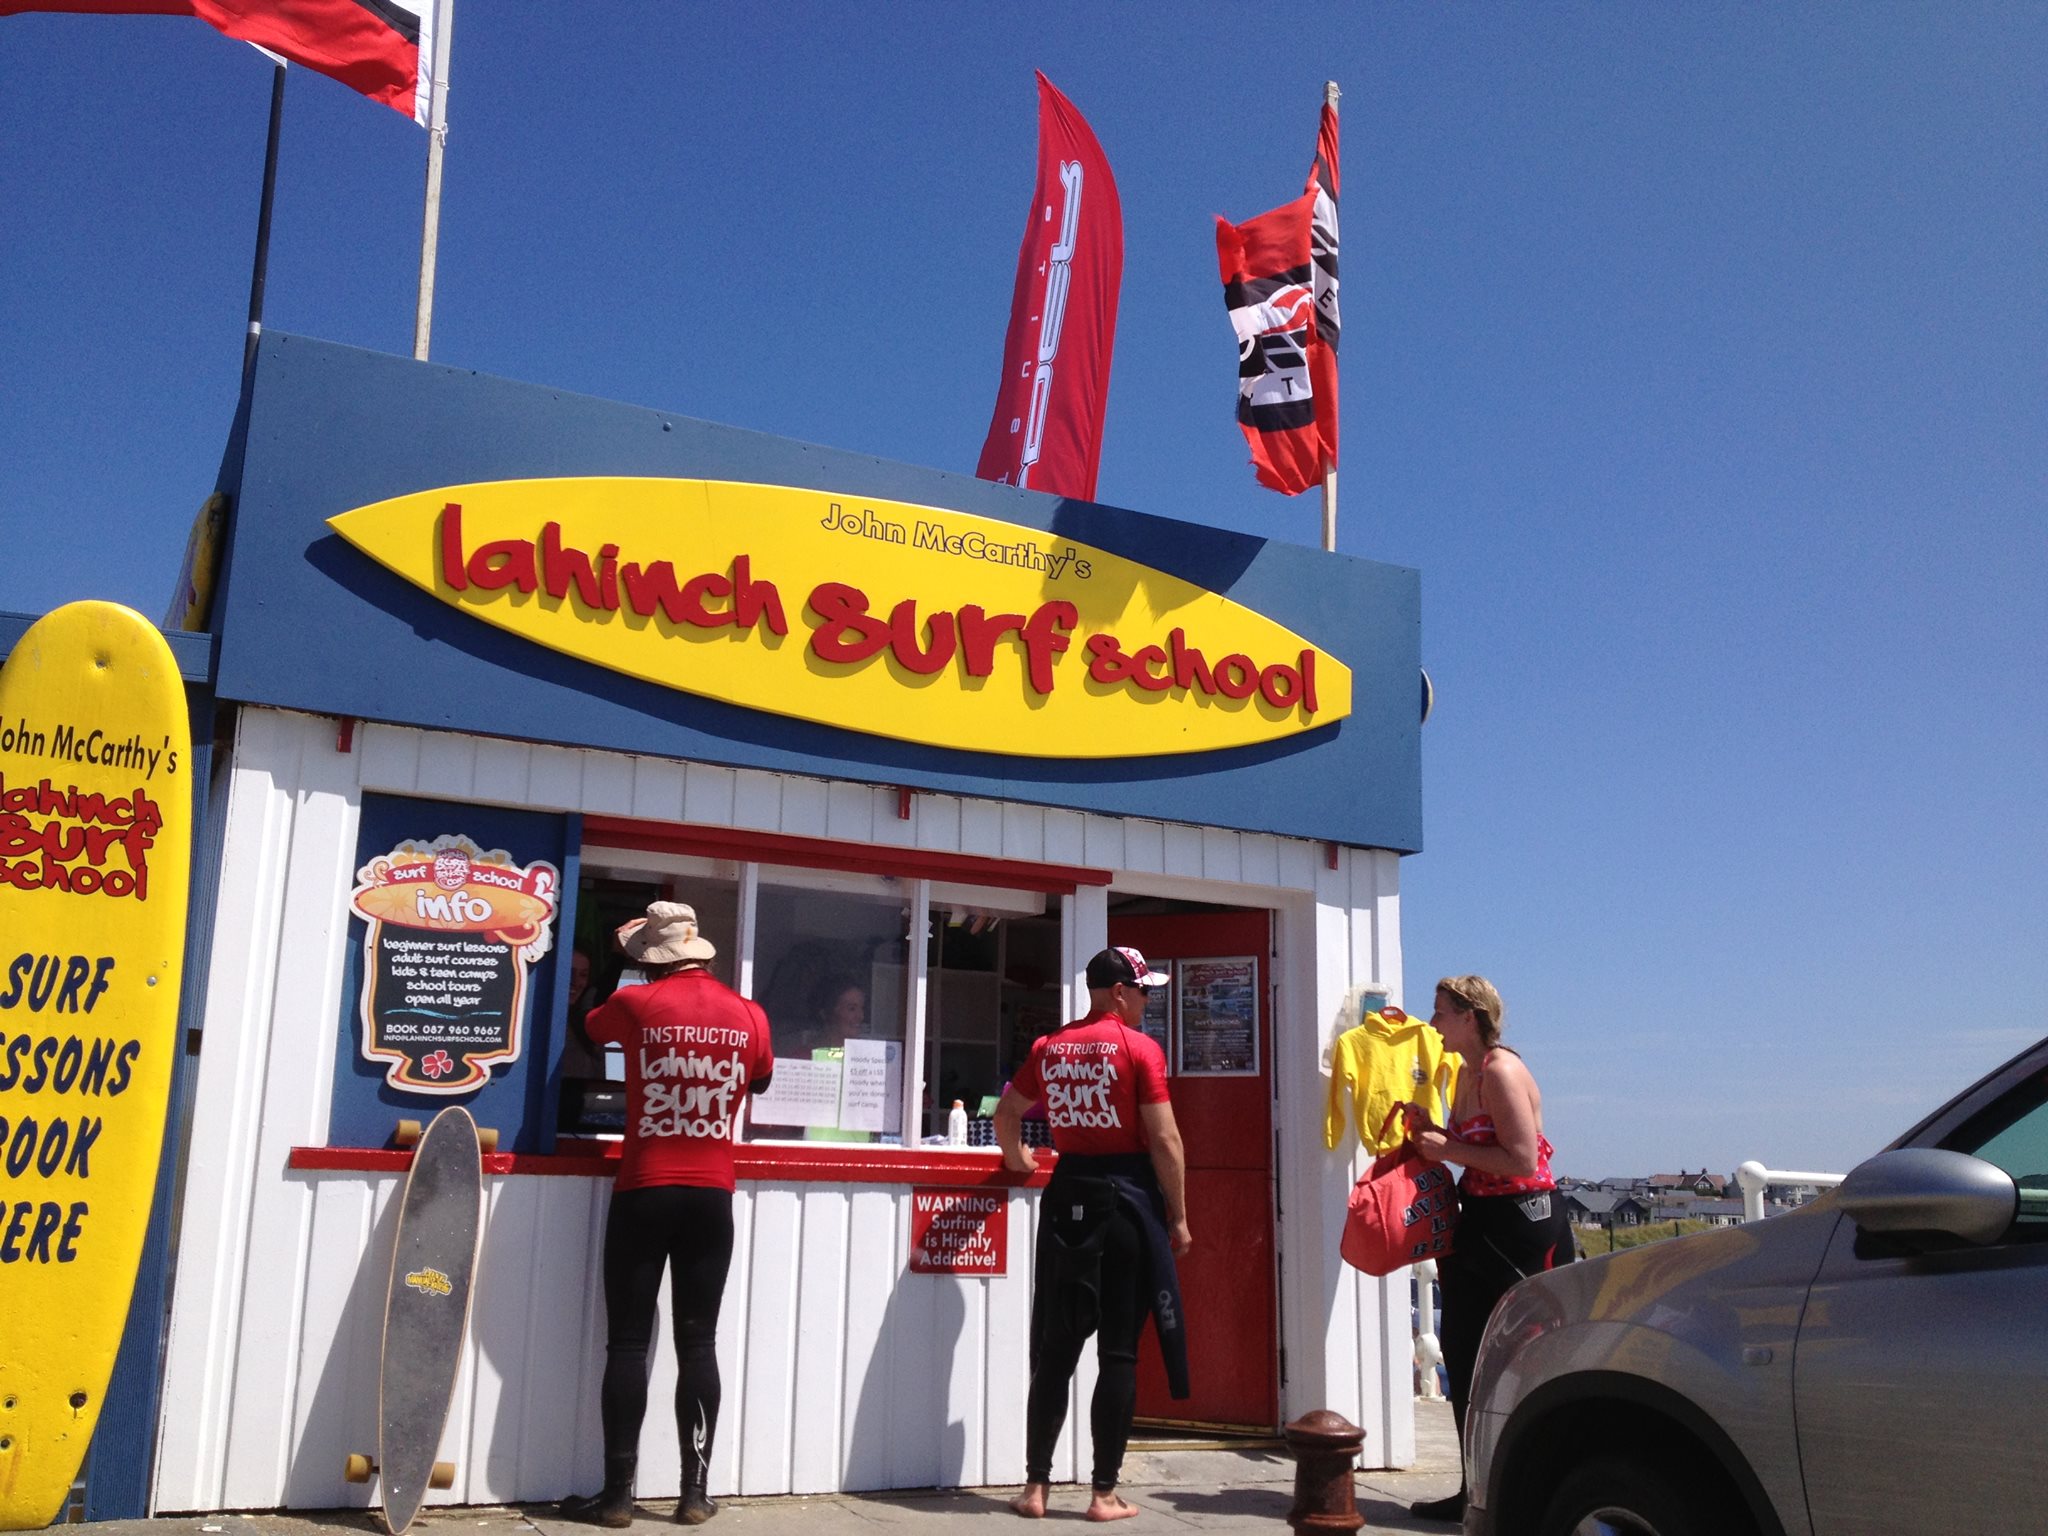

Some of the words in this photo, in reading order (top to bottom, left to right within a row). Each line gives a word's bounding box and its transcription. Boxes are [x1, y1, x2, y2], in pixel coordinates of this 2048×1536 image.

[821, 503, 906, 545] John
[913, 520, 1092, 579] McCarthy's
[441, 502, 789, 636] lahinch
[808, 582, 1079, 694] surf
[1088, 626, 1319, 714] school
[0, 716, 45, 757] ohn
[51, 724, 178, 781] McCarthy's
[393, 865, 427, 881] surf
[472, 871, 523, 892] school
[416, 888, 493, 923] info
[383, 938, 435, 953] beginner
[437, 942, 462, 952] surf
[463, 942, 509, 954] lessons
[391, 953, 424, 964] adult
[424, 955, 451, 965] surf
[451, 957, 499, 967] courses
[0, 952, 116, 1014] SURF
[391, 966, 418, 977] kids
[419, 967, 429, 977] &
[429, 967, 457, 979] teen
[458, 971, 498, 983] camps
[406, 980, 447, 991] school
[447, 980, 482, 992] tours
[404, 995, 435, 1007] open
[436, 994, 452, 1005] all
[452, 997, 483, 1008] year
[386, 1024, 419, 1034] BOOK
[422, 1025, 444, 1034] 087
[448, 1026, 470, 1035] 960
[473, 1026, 501, 1036] 9667
[641, 1025, 749, 1049] INSTRUCTOR
[1045, 1042, 1118, 1056] INSTRUCTOR
[639, 1046, 746, 1085] lahinch
[1041, 1056, 1119, 1082] lahinch
[643, 1080, 737, 1120] surf
[1046, 1078, 1111, 1112] surf
[638, 1109, 732, 1141] school
[1048, 1104, 1122, 1129] school
[917, 1195, 1002, 1213] WARNING:
[0, 1201, 89, 1264] ERE
[931, 1213, 986, 1234] Surfing
[925, 1232, 938, 1248] is
[942, 1231, 992, 1253] Highly
[920, 1249, 997, 1267] Addictive!
